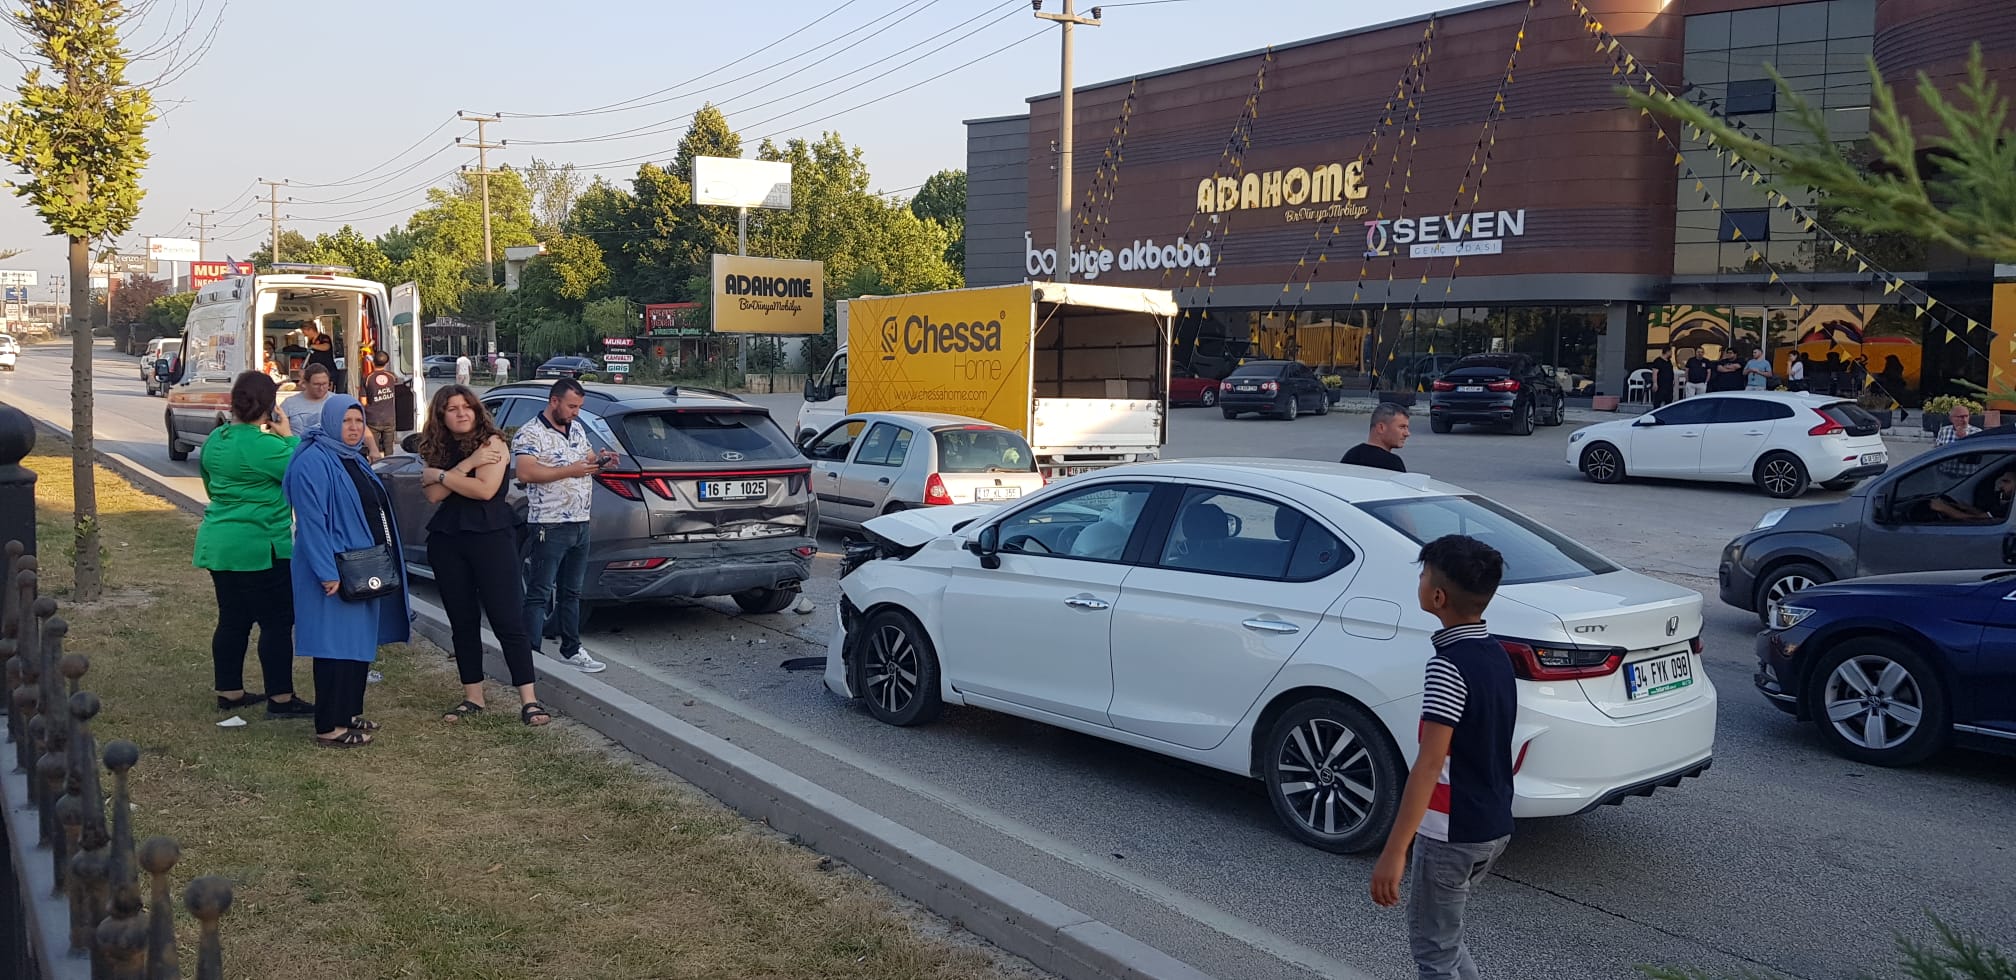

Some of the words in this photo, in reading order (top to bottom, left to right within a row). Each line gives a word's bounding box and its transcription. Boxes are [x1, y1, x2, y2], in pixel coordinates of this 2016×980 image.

[1197, 160, 1369, 214] ADAHOME
[1392, 209, 1525, 244] SEVEN
[1118, 237, 1211, 271] akbaba
[725, 274, 813, 298] ADAHOME
[903, 314, 1002, 355] Chessa
[953, 353, 1002, 381] Home
[894, 386, 988, 401] www.chessahome.com
[708, 484, 719, 496] 16
[725, 483, 732, 495] F
[741, 482, 765, 495] 1025
[1574, 624, 1609, 634] CITY
[1634, 664, 1648, 688] 34
[1651, 660, 1669, 685] FYK
[1671, 656, 1688, 679] 098
